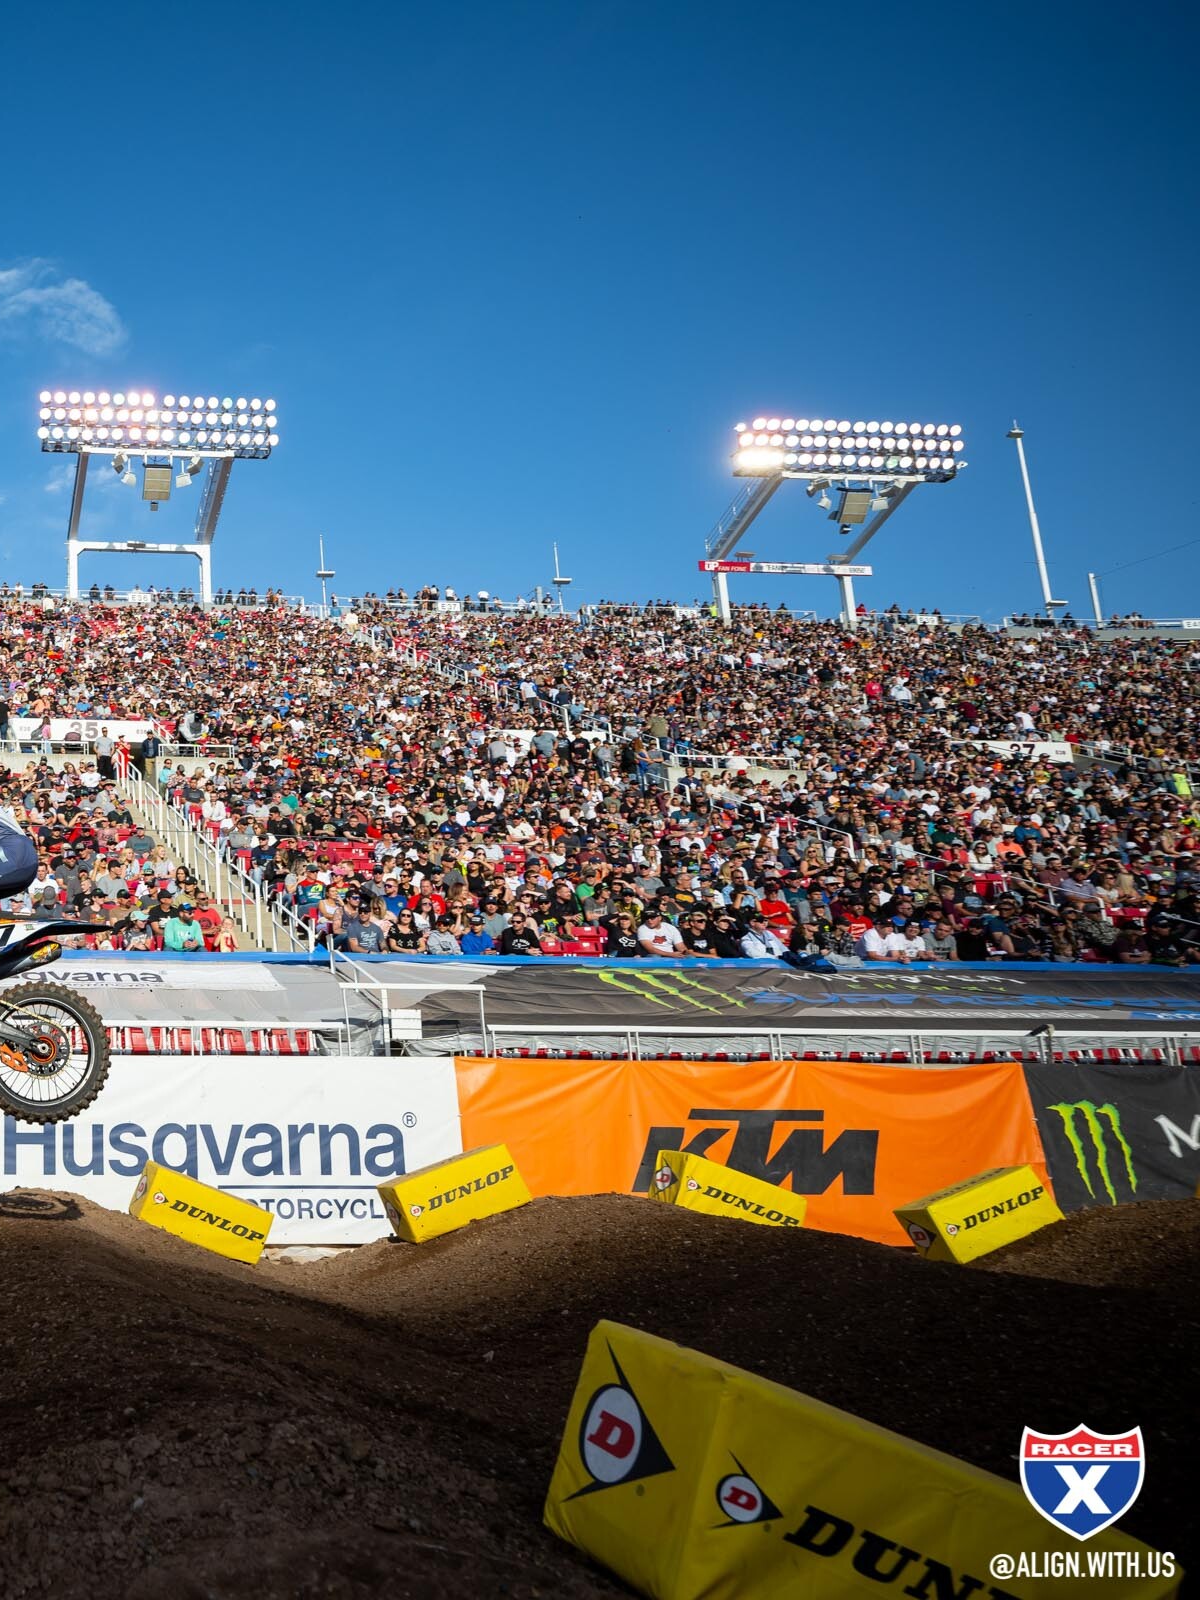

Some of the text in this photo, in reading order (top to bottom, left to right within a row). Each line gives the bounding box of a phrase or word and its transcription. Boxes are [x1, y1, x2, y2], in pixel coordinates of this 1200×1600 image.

[70, 721, 99, 739] 35
[8, 970, 164, 983] qvarna
[631, 1108, 880, 1195] KTM
[245, 1198, 392, 1220] TORCYCL
[428, 1164, 514, 1211] DUNLOP
[702, 1185, 800, 1227] DUNLOP
[963, 1185, 1044, 1230] DUNLOP
[169, 1199, 265, 1242] DUNLOP
[783, 1504, 1026, 1600] DUN
